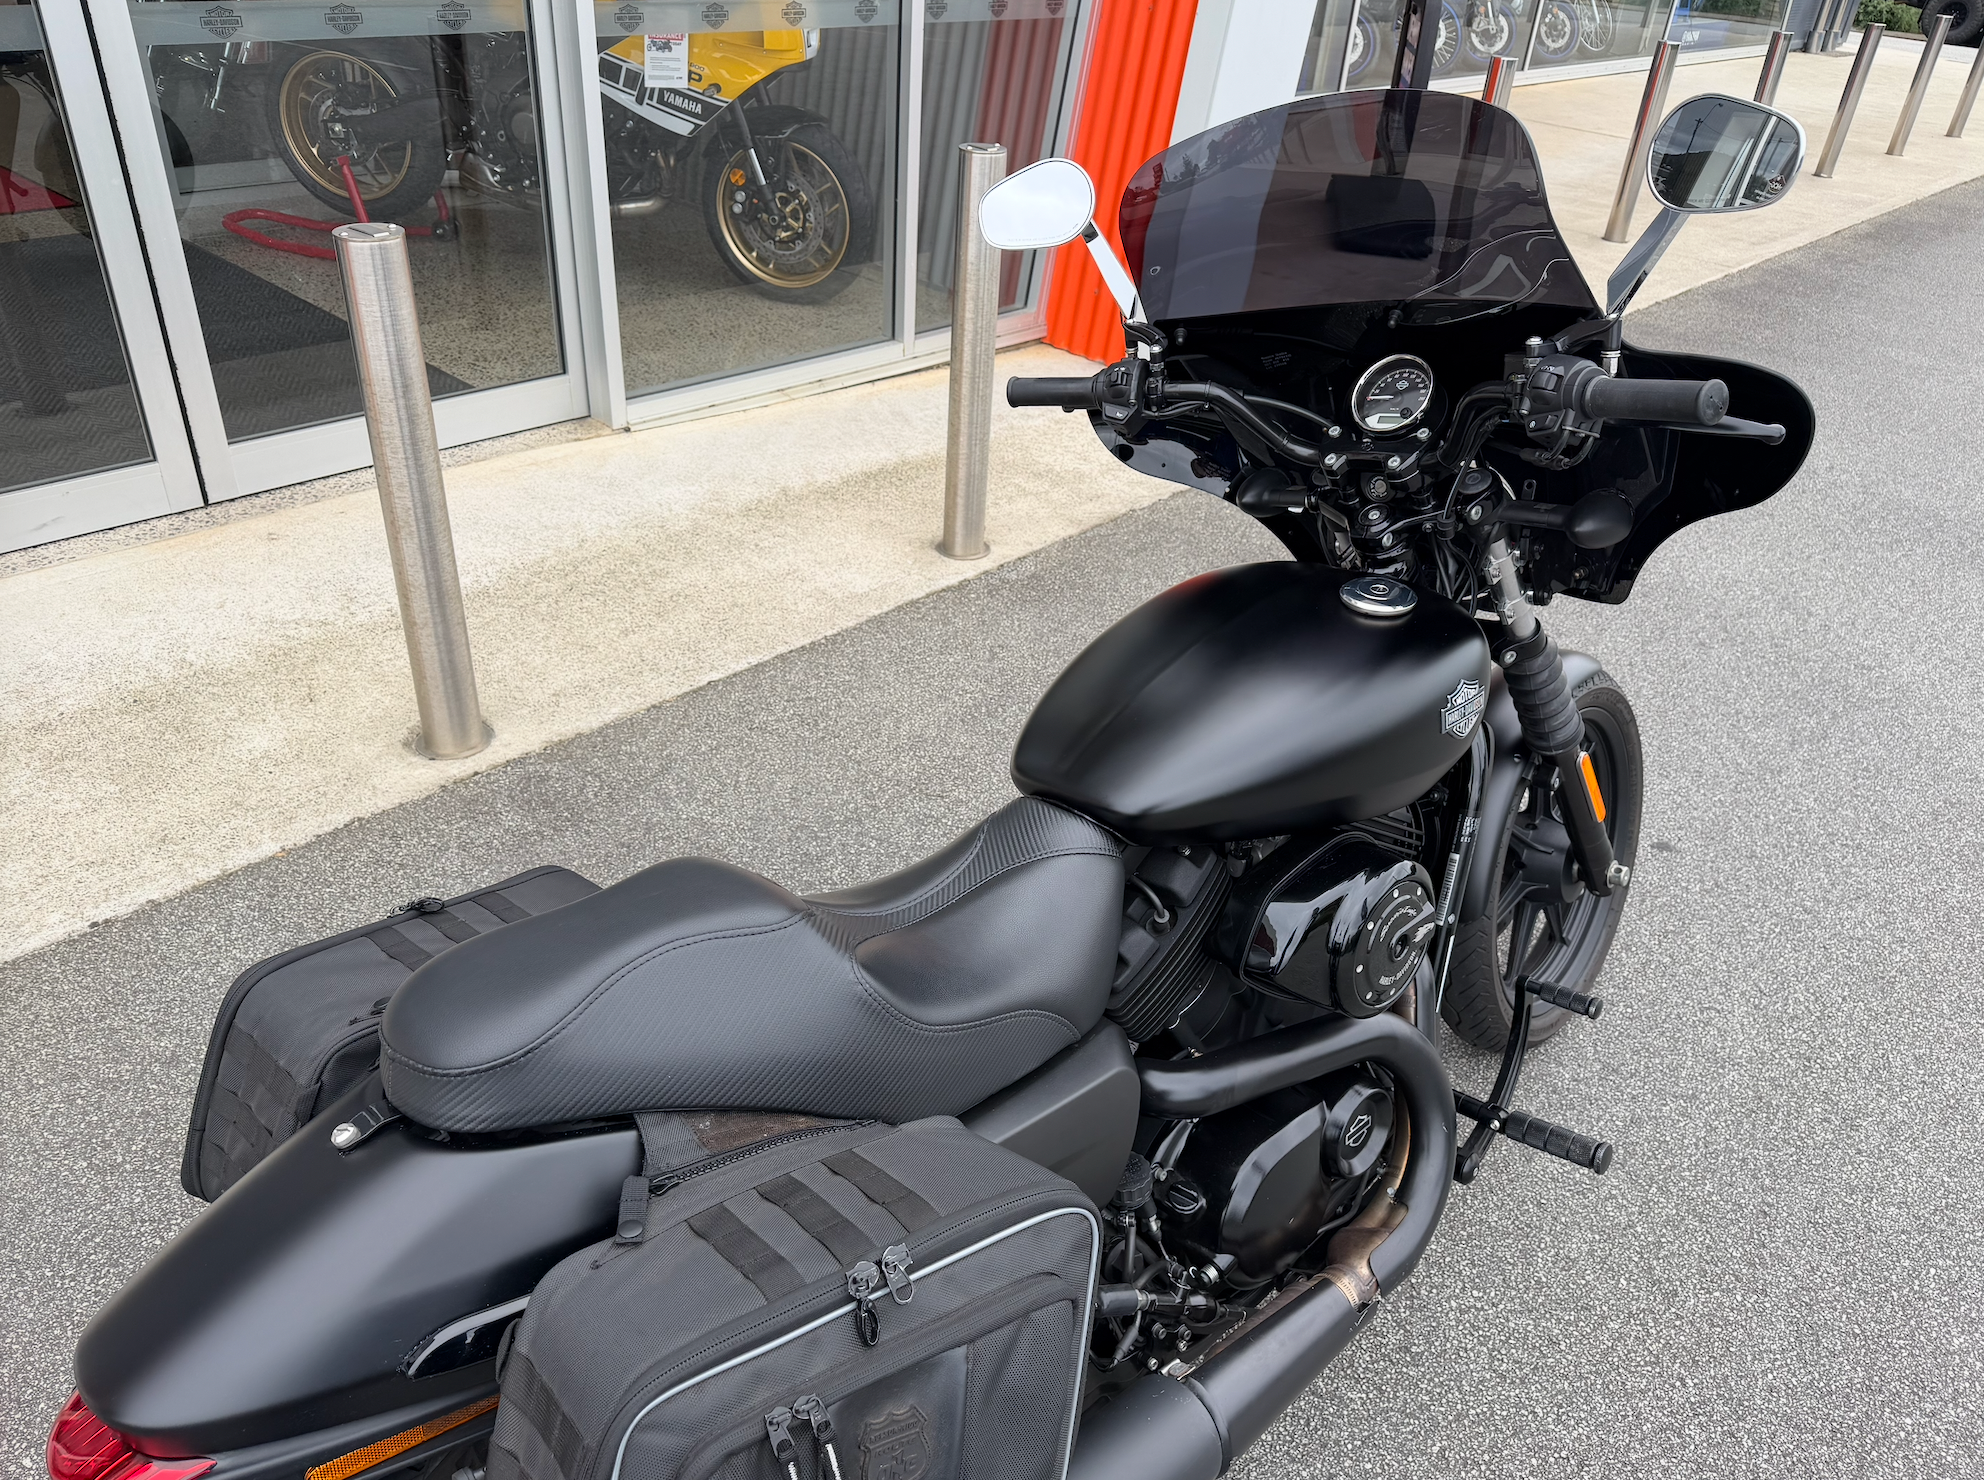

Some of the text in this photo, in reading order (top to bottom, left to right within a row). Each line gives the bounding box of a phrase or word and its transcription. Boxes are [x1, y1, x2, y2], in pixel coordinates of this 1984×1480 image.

[664, 90, 702, 115] YAMAHA
[1447, 693, 1483, 727] HARLEY-DAVIDSON
[1455, 687, 1478, 707] MOTOR
[1379, 949, 1417, 986] HARLEY-DAVIDSON
